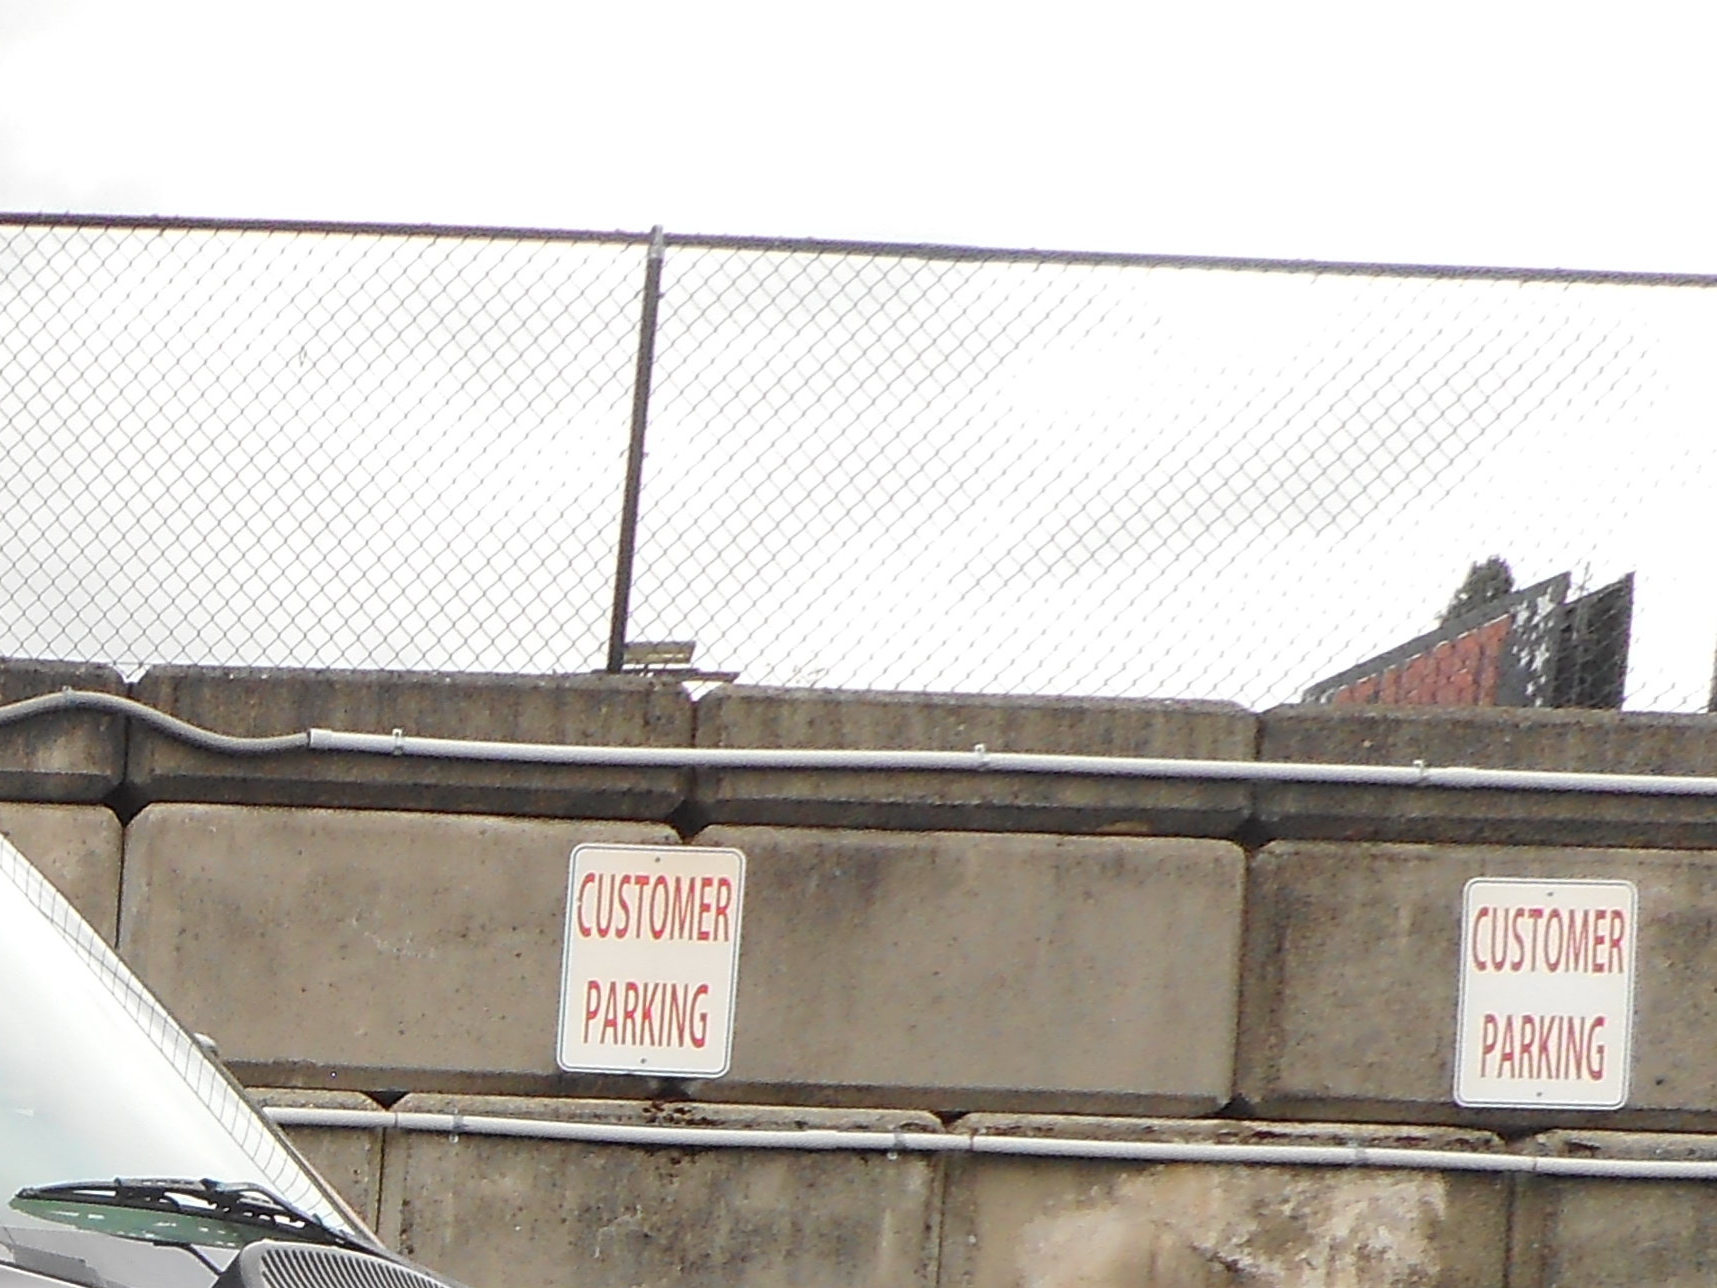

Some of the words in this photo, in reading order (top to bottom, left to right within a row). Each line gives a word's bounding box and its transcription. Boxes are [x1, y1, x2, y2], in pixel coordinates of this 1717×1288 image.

[577, 872, 733, 942] CUSTOMER
[1472, 906, 1626, 974] CUSTOMER
[583, 979, 709, 1048] PARKING
[1480, 1013, 1606, 1081] PARKING
